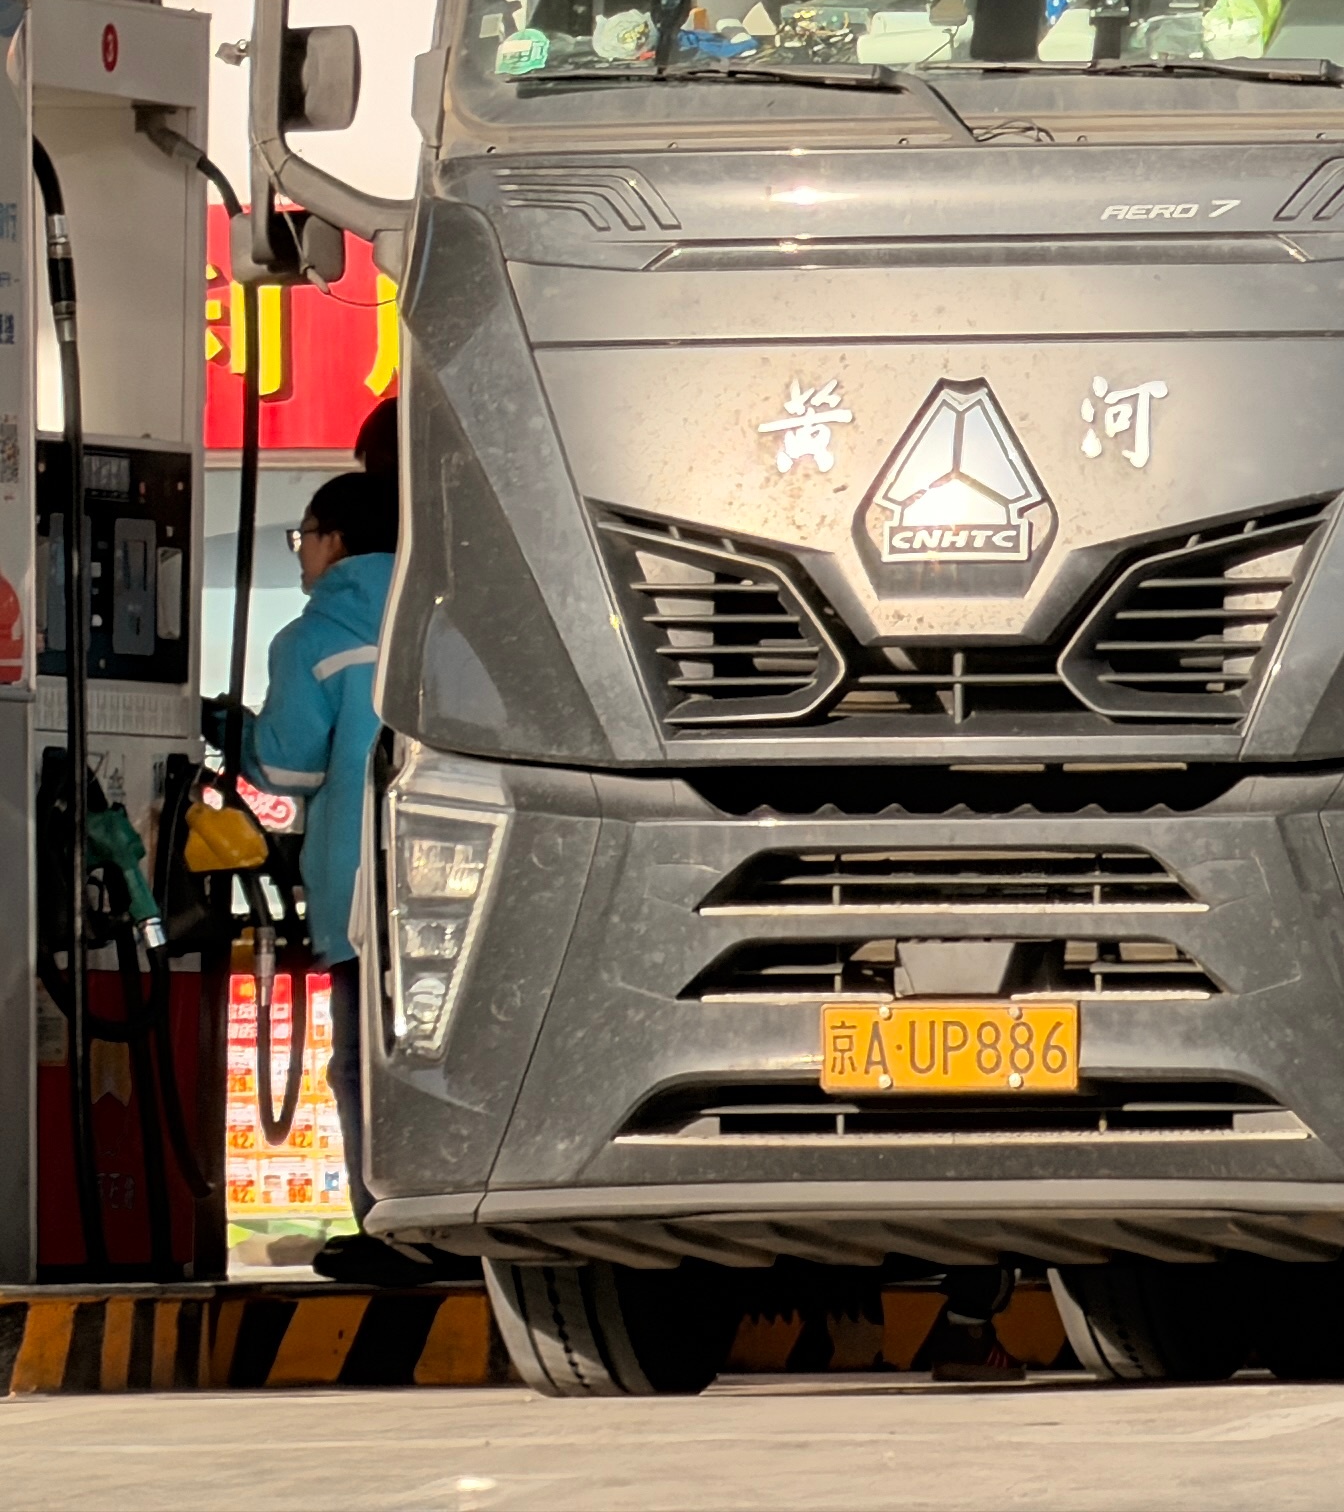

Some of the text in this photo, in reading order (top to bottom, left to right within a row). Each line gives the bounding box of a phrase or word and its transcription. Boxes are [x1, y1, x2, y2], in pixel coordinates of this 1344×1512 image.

[1100, 199, 1242, 221] AERO 7
[1080, 375, 1169, 468] 河
[891, 528, 1018, 550] CNHTC
